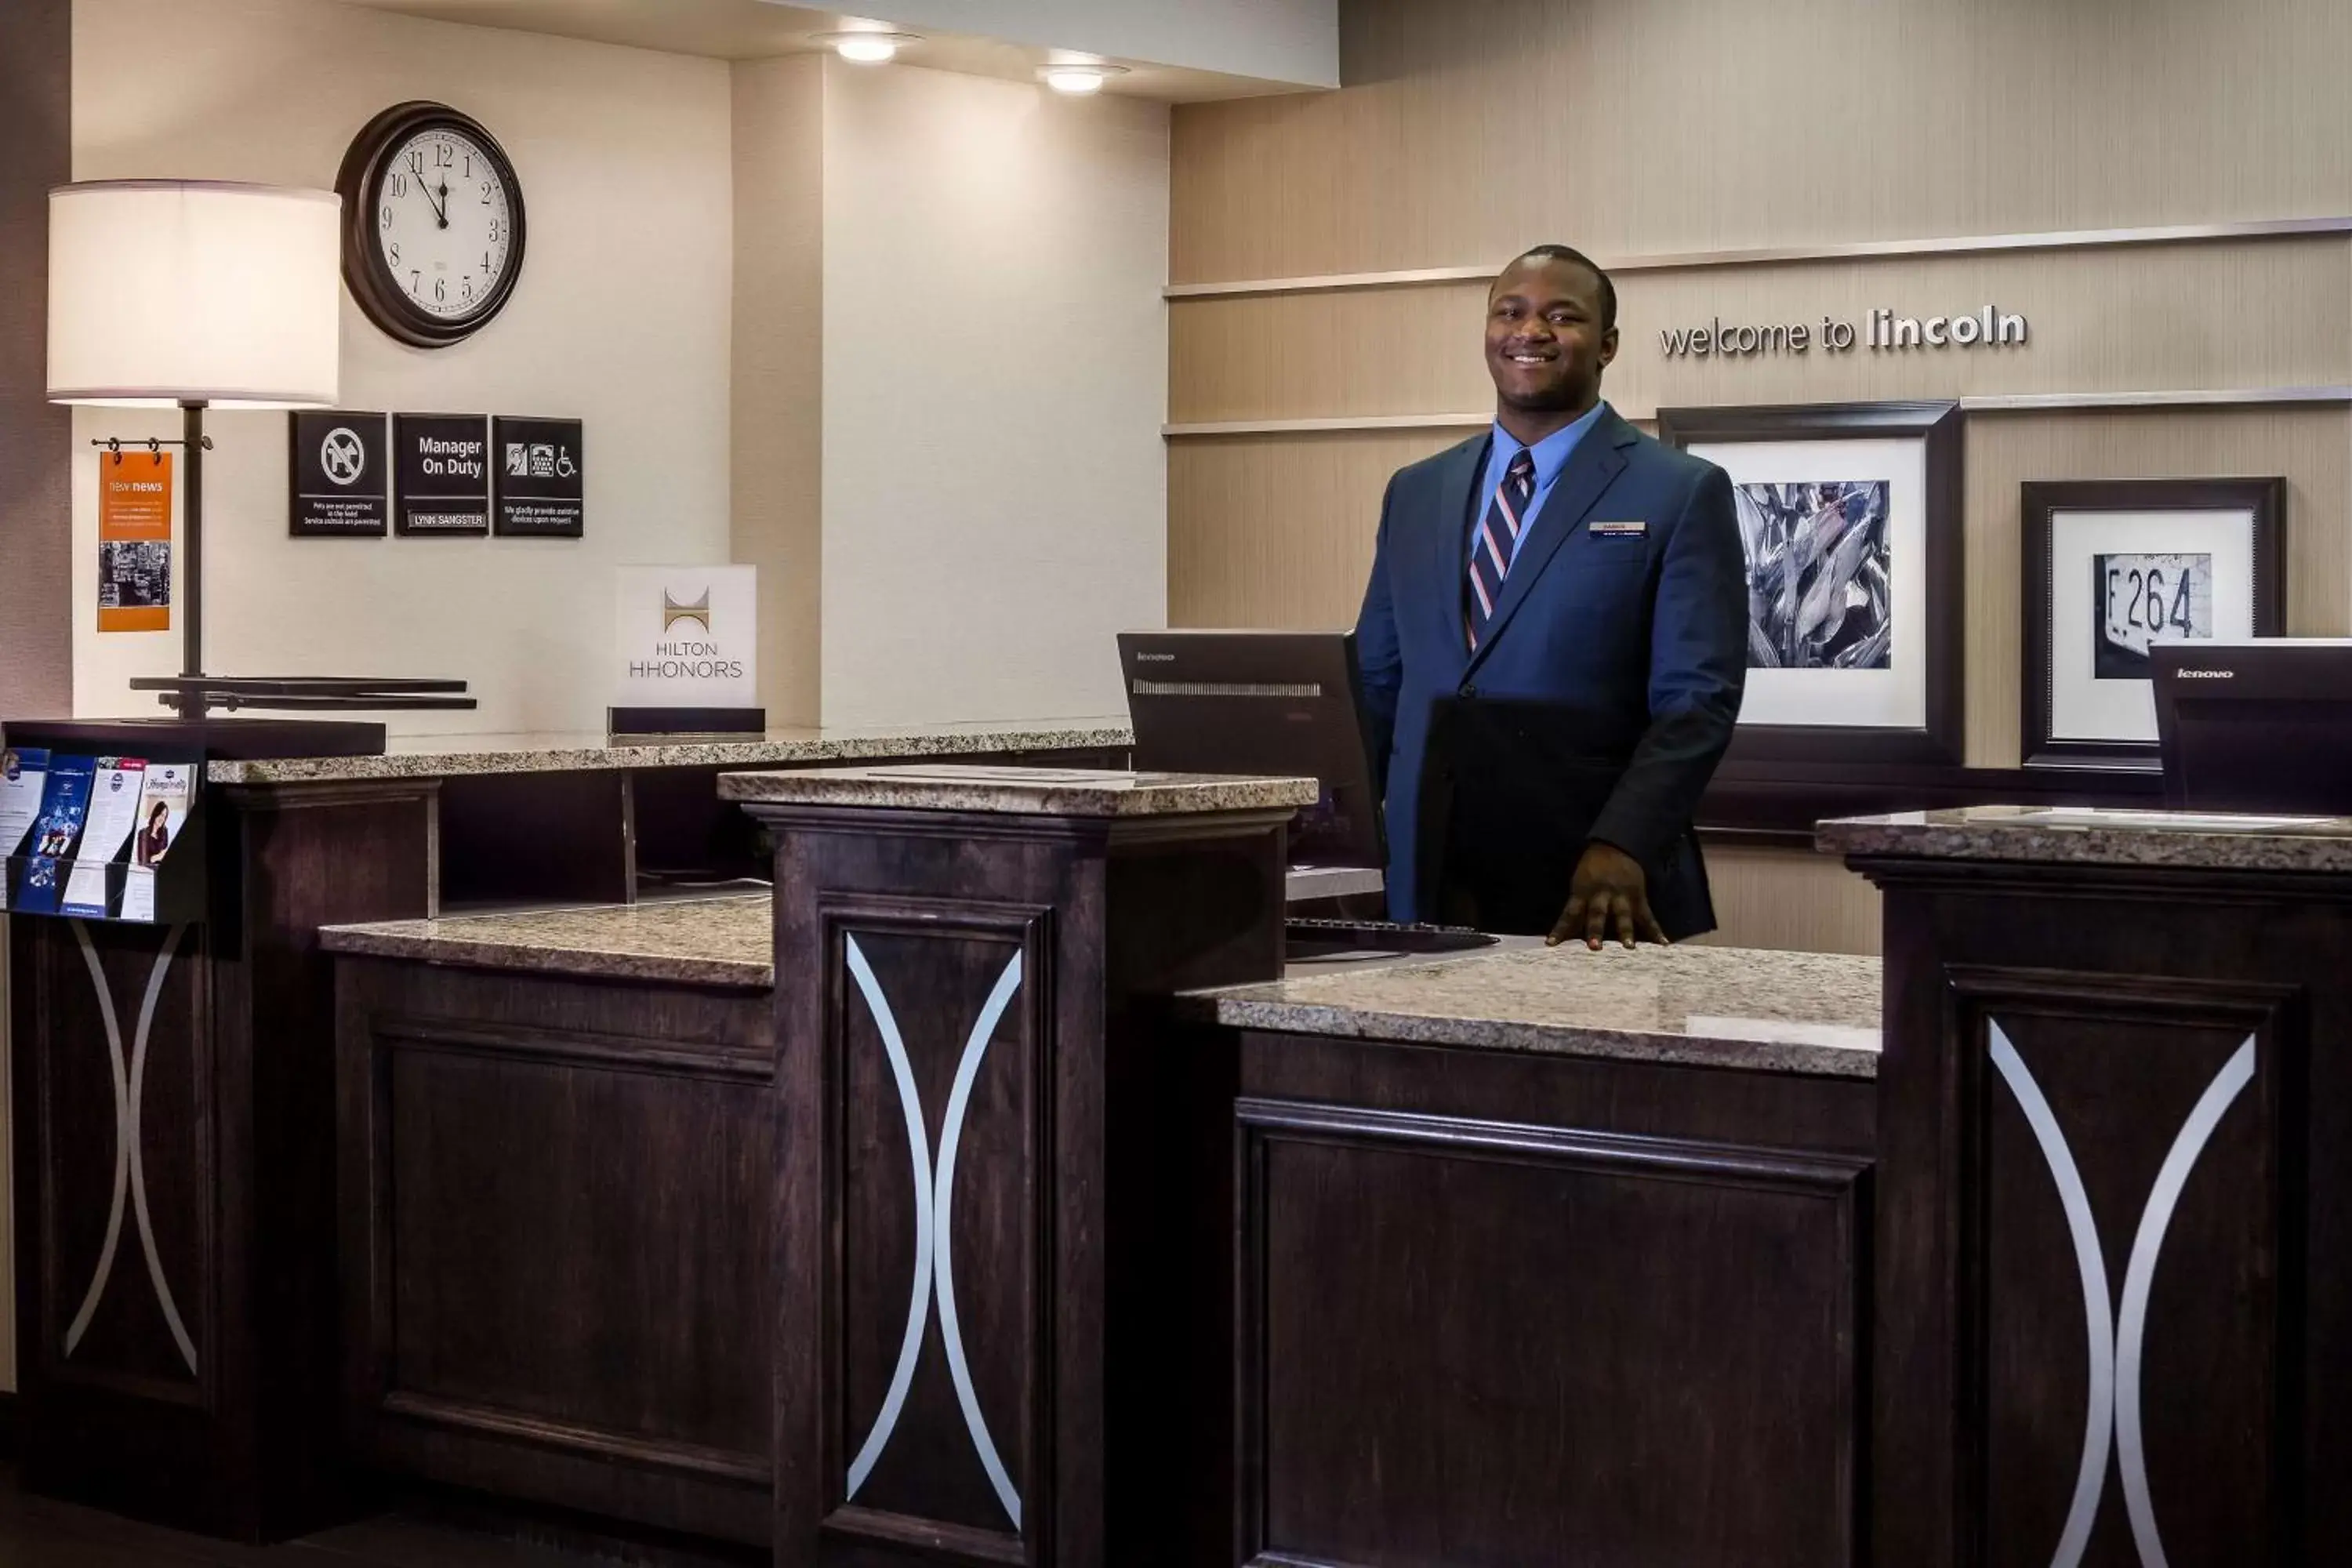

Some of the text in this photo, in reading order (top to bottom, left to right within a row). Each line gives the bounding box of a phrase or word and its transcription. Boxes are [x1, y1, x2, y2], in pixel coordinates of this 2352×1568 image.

[411, 151, 423, 175] 11
[434, 144, 452, 167] 12
[464, 155, 470, 178] 1
[390, 173, 407, 198] 10
[481, 181, 492, 205] 2
[382, 205, 392, 230] 9
[488, 219, 499, 242] 3
[390, 242, 401, 267] 8
[480, 250, 491, 274] 4
[410, 270, 421, 293] 7
[434, 278, 445, 302] 6
[462, 275, 471, 299] 5
[1658, 304, 2027, 356] welcome to lincoln
[419, 437, 482, 458] Manager
[423, 458, 481, 479] On Duty
[132, 481, 163, 492] news
[438, 515, 483, 524] SANGSTER
[655, 642, 718, 656] HILTON
[1137, 652, 1175, 662] lenovo
[629, 660, 743, 678] HHONORS
[2177, 669, 2234, 679] lenovo
